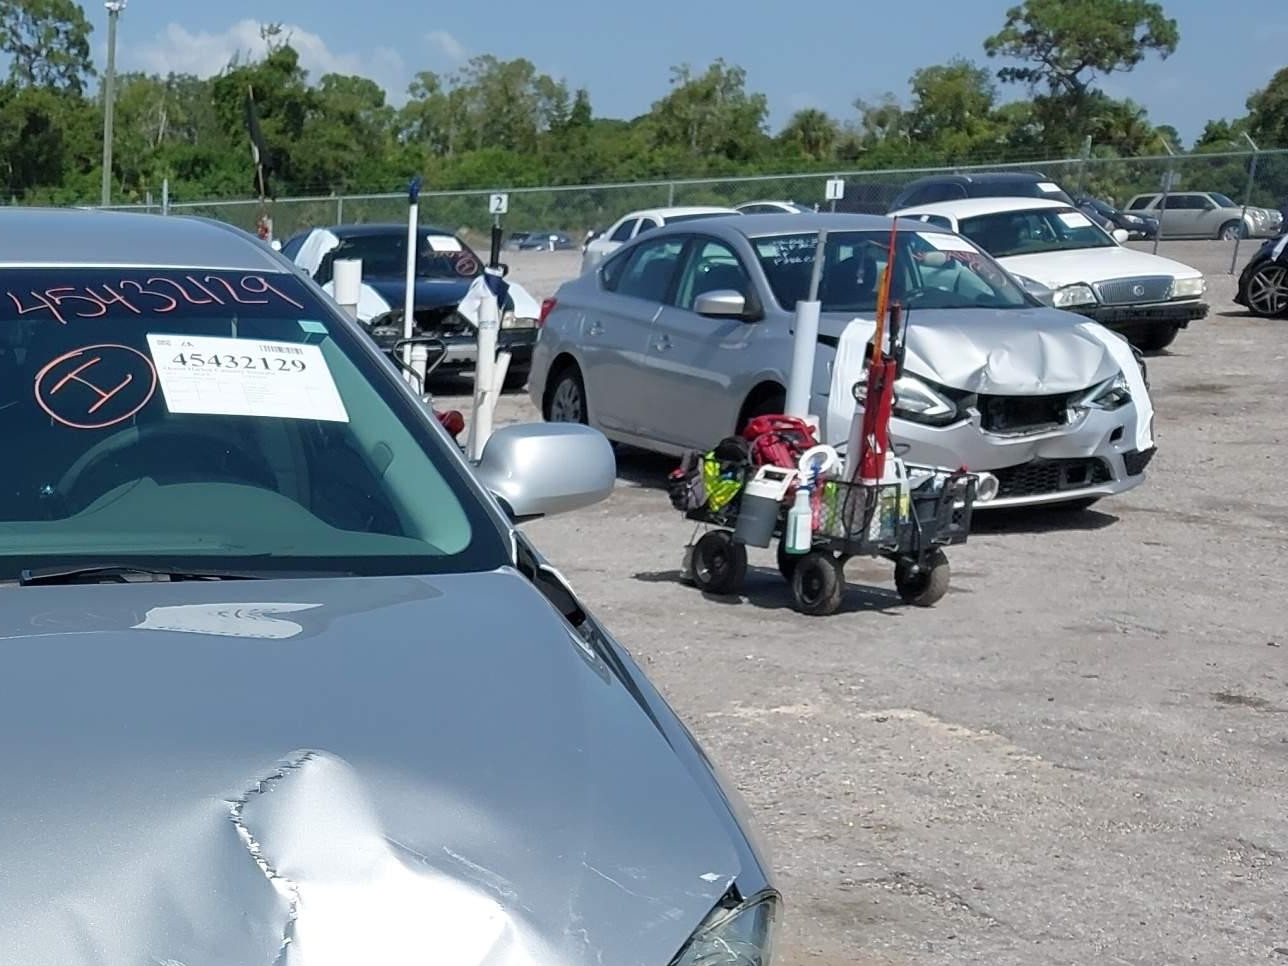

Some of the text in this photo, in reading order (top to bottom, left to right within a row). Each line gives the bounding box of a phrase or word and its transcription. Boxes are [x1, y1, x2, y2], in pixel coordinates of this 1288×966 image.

[495, 196, 503, 211] 2
[7, 275, 304, 324] 45432129
[172, 352, 307, 373] 45432129
